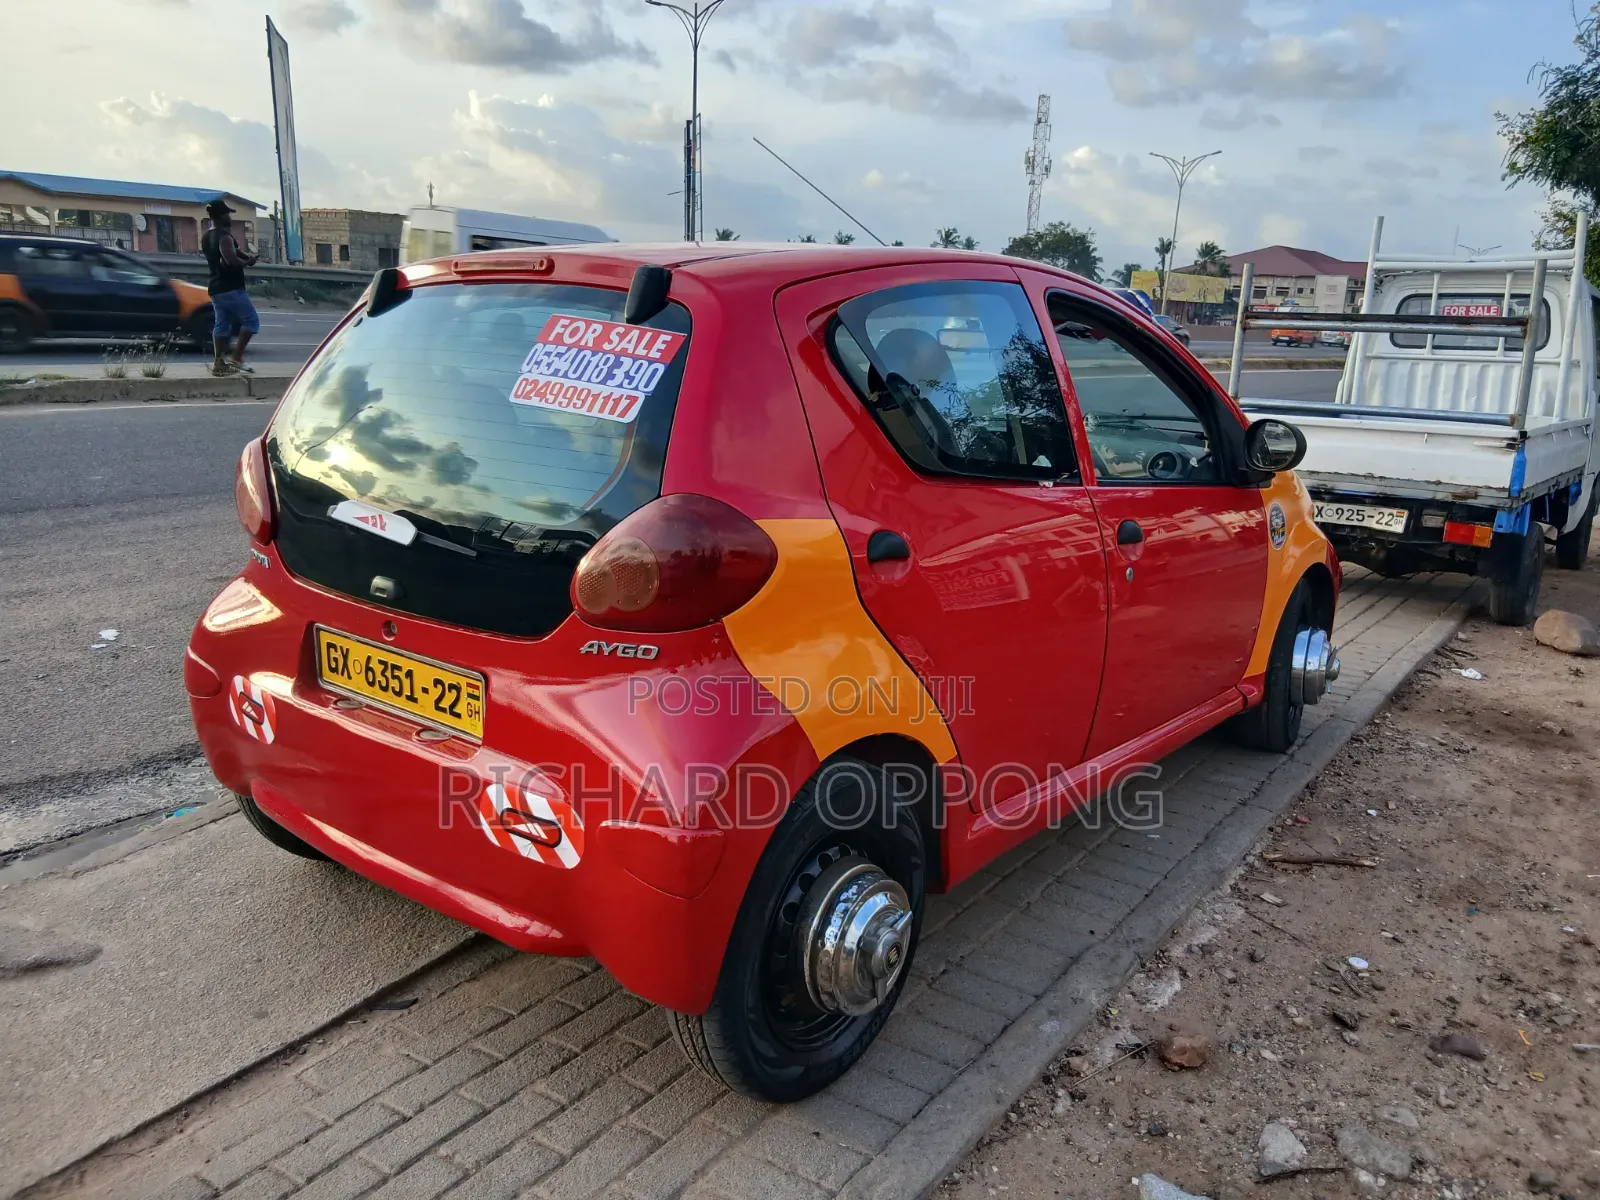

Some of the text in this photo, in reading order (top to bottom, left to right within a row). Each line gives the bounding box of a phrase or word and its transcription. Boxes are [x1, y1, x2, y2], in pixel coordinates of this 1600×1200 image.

[1444, 306, 1498, 316] FOR SALE
[548, 319, 672, 358] FOR SALE
[514, 378, 640, 418] 0249991117
[1335, 508, 1395, 527] 925-22
[579, 640, 660, 661] AYGO
[326, 641, 462, 719] GX 6351-22
[466, 701, 481, 723] GH
